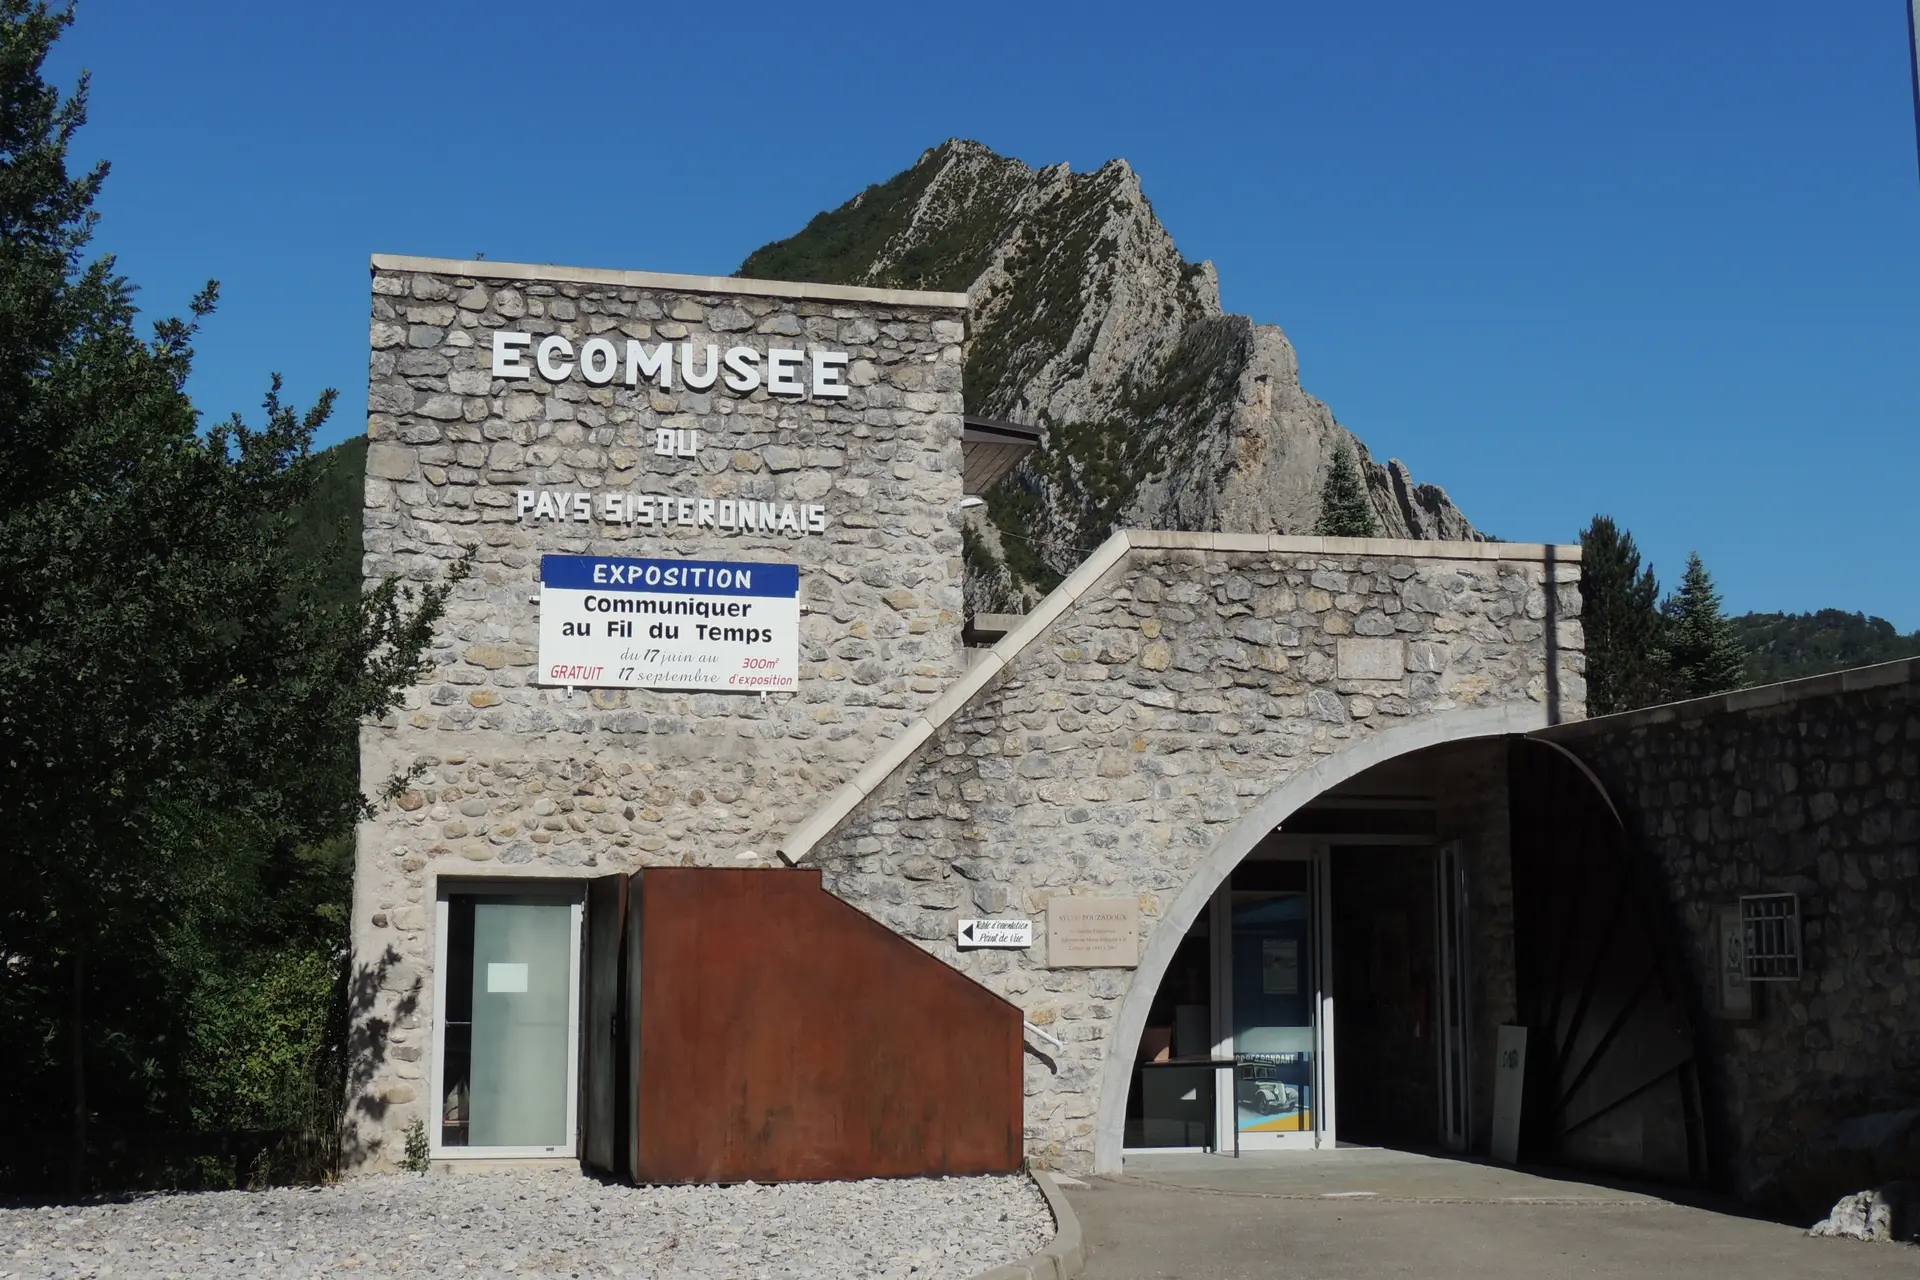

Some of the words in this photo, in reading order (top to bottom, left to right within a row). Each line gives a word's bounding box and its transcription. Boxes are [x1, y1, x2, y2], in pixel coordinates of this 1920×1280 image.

[492, 331, 849, 397] ECOMUSEE
[654, 428, 697, 456] DU
[517, 490, 591, 520] PAYS
[605, 494, 825, 532] SISTERONNAIS
[593, 564, 751, 589] EXPOSITION
[584, 595, 752, 618] Communiquer
[562, 621, 591, 637] au
[607, 620, 633, 638] Fil
[649, 622, 680, 640] du
[696, 624, 773, 644] Temps
[620, 647, 640, 661] du
[643, 649, 660, 663] 17
[660, 651, 695, 666] juin
[698, 653, 720, 663] au
[550, 665, 604, 680] GRATUIT
[618, 667, 635, 681] 17
[637, 668, 720, 685] septembre
[728, 674, 793, 687] d'exposition
